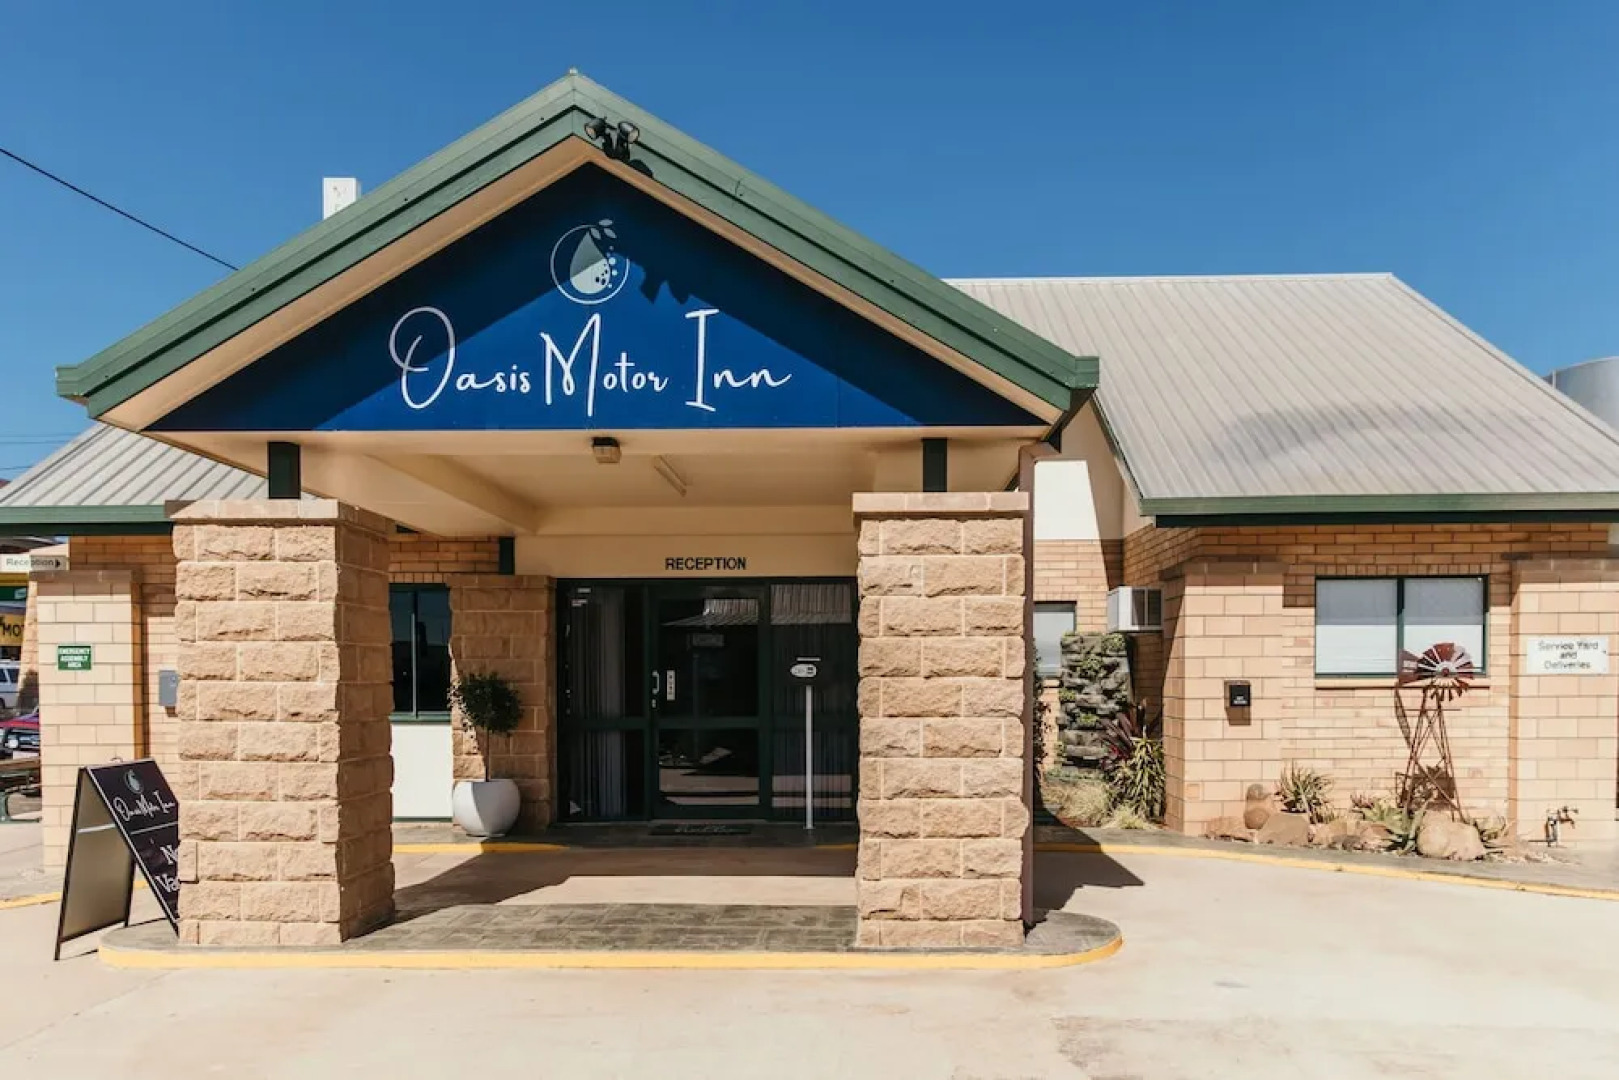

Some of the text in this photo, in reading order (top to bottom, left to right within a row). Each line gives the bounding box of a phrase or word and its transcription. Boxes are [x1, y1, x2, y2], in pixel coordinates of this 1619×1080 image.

[389, 306, 792, 417] Oasis Motor Inn
[6, 558, 54, 568] Reception
[664, 556, 747, 571] RECEPTION
[1537, 641, 1599, 651] Service Yard
[1560, 651, 1578, 660] and
[1544, 660, 1591, 670] Deliveries
